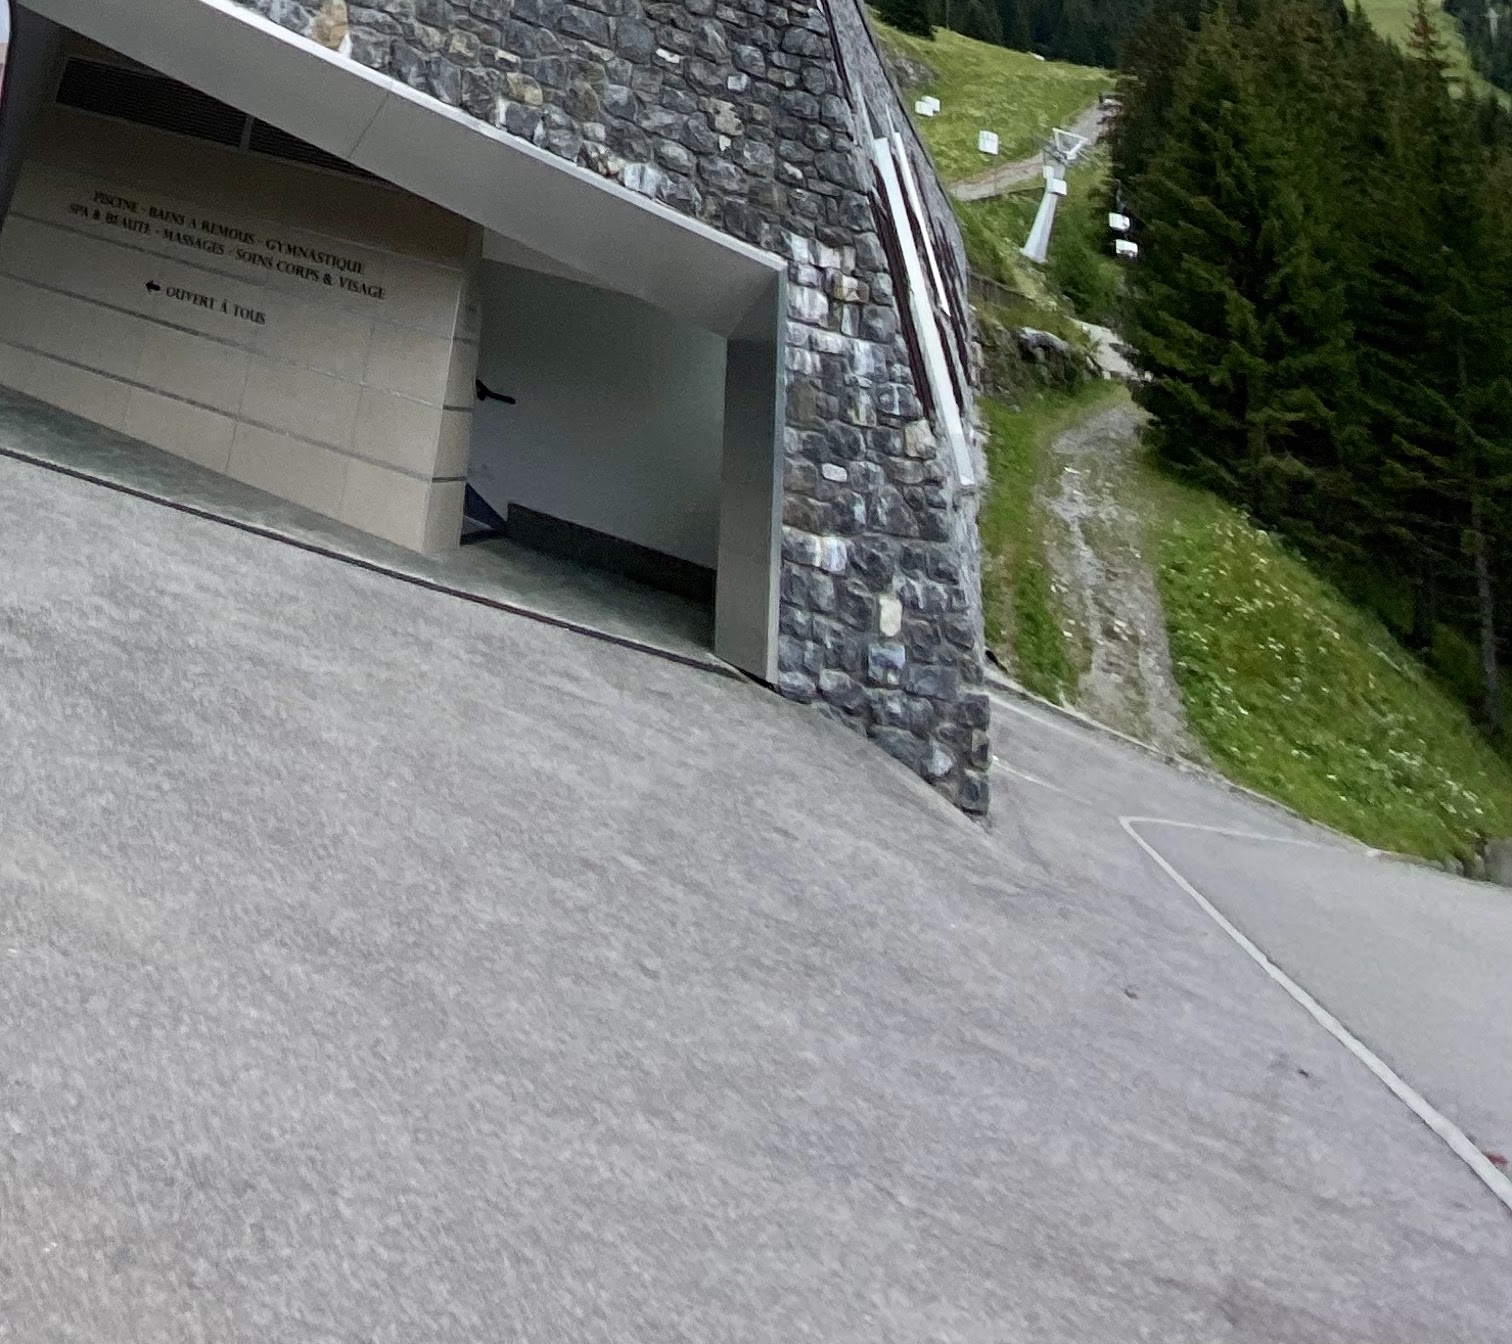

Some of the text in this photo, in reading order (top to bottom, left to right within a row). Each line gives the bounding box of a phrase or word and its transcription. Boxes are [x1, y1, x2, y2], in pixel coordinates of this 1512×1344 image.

[70, 203, 88, 217] SPA
[163, 228, 226, 255] MASSAGES
[235, 248, 274, 270] SOINS
[276, 261, 320, 282] CORPS
[323, 273, 333, 286] &
[338, 276, 386, 300] VISAGE
[93, 189, 138, 212] PISCINE
[148, 206, 186, 226] BAINS
[201, 220, 255, 244] REMOUS
[265, 238, 365, 275] GYMNASTIQUE
[165, 286, 216, 310] OUVERT
[232, 303, 267, 325] TOUS
